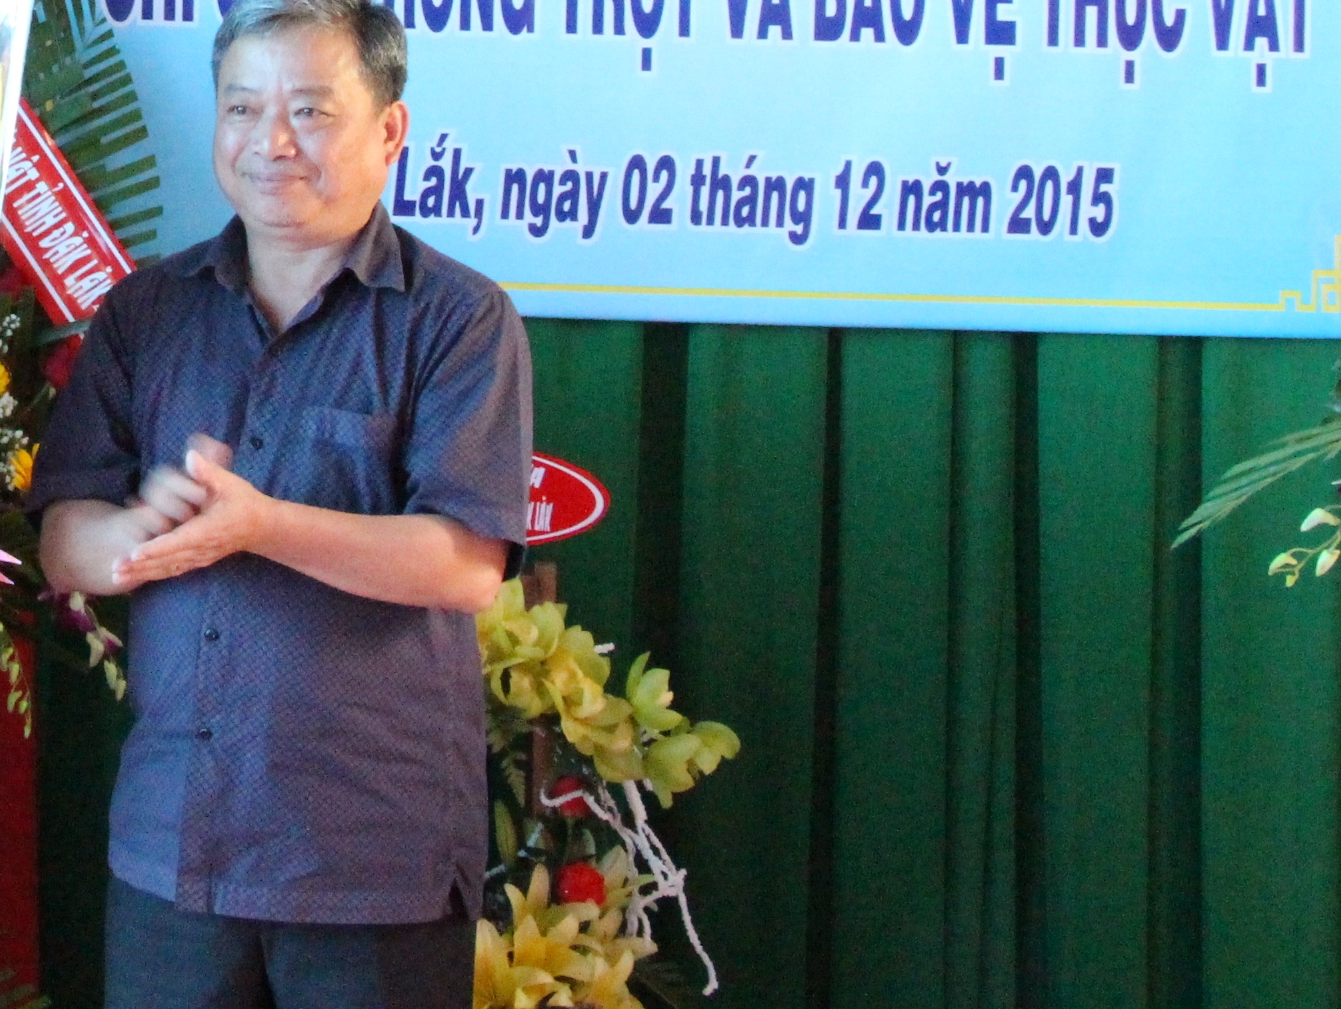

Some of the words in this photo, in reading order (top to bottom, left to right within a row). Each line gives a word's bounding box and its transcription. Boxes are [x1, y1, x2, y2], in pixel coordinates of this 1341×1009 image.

[12, 181, 68, 237] TỈNH
[392, 133, 485, 232] Lắk,
[499, 149, 608, 240] ngày
[622, 153, 676, 226] 02
[690, 154, 817, 245] tháng
[834, 159, 885, 232] 12
[896, 160, 993, 235] năm
[1006, 164, 1115, 239] 2015
